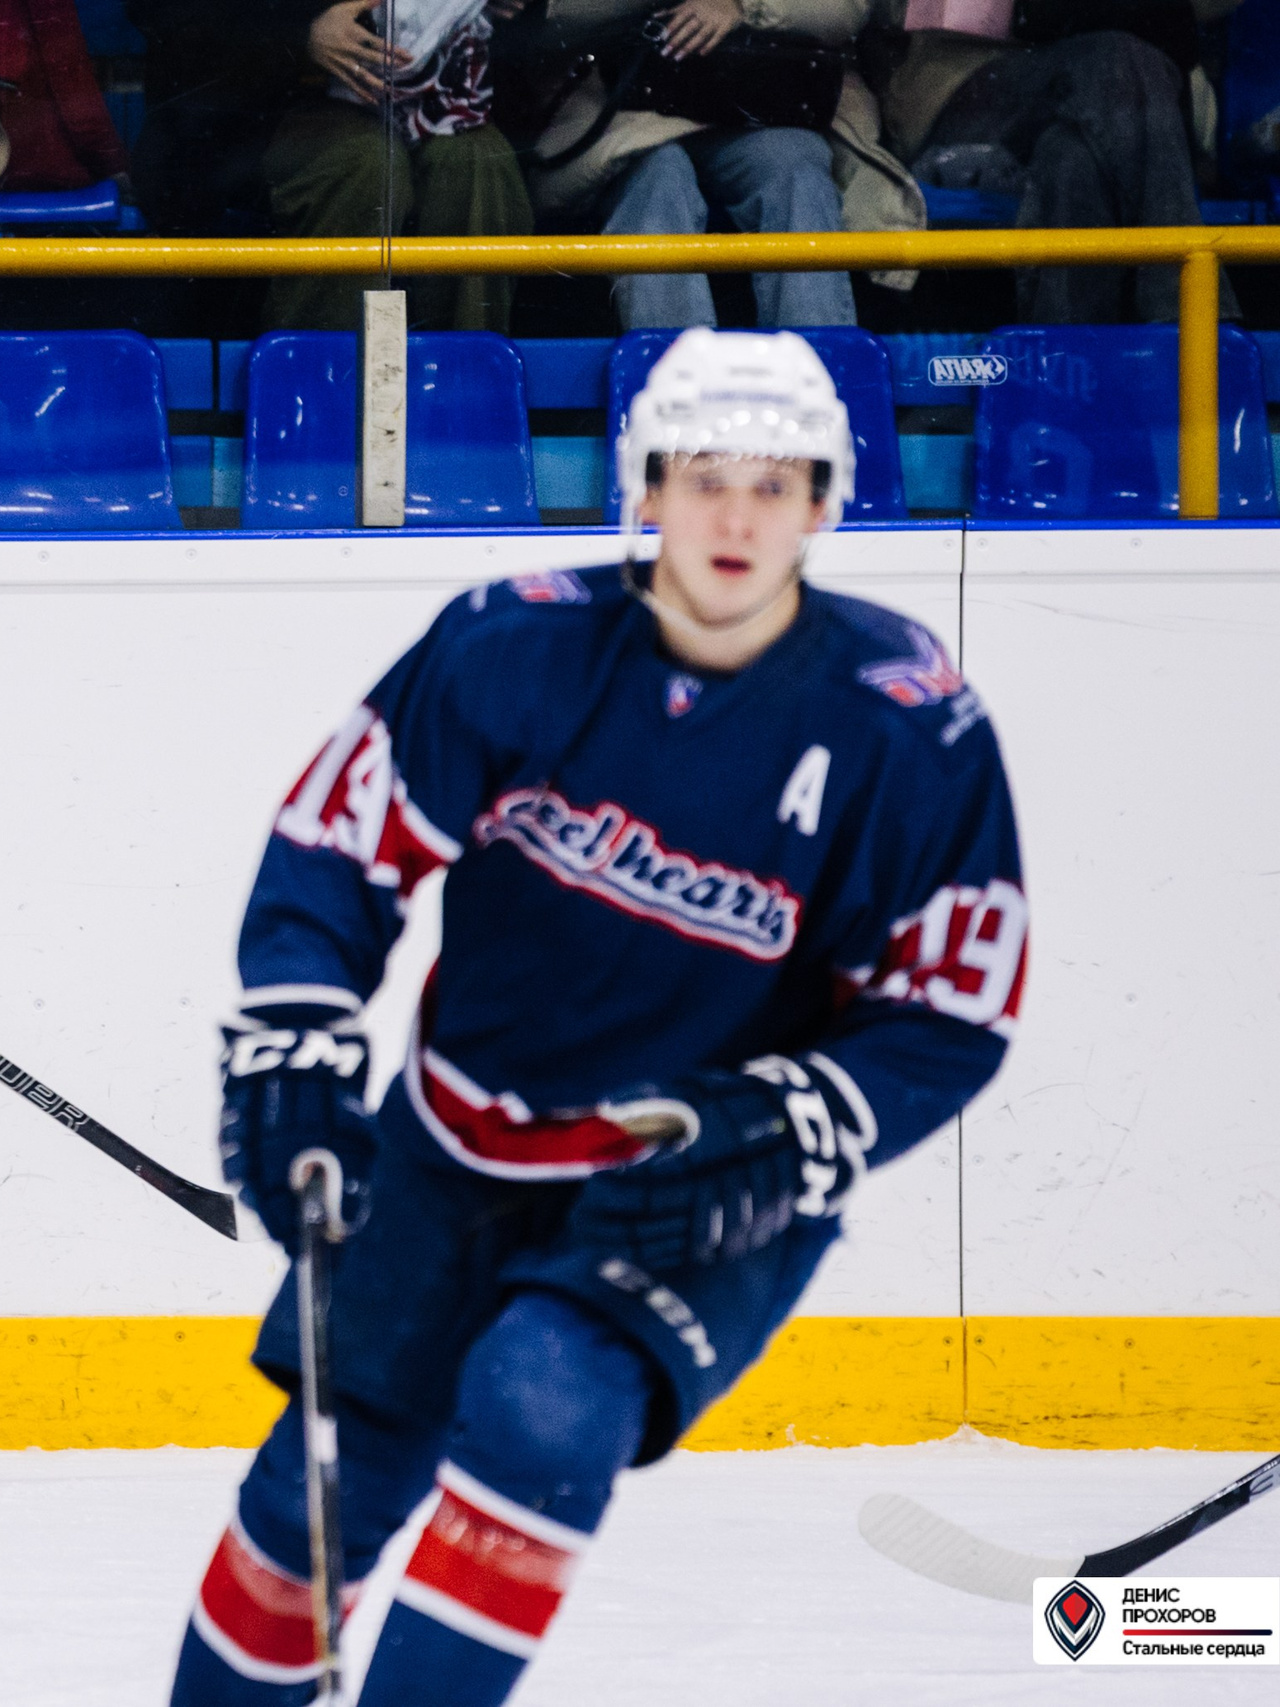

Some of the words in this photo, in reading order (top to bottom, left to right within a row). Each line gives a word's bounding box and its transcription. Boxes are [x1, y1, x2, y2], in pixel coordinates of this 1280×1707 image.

[273, 703, 393, 868] 19
[776, 743, 832, 837] A
[885, 878, 1029, 1025] 19
